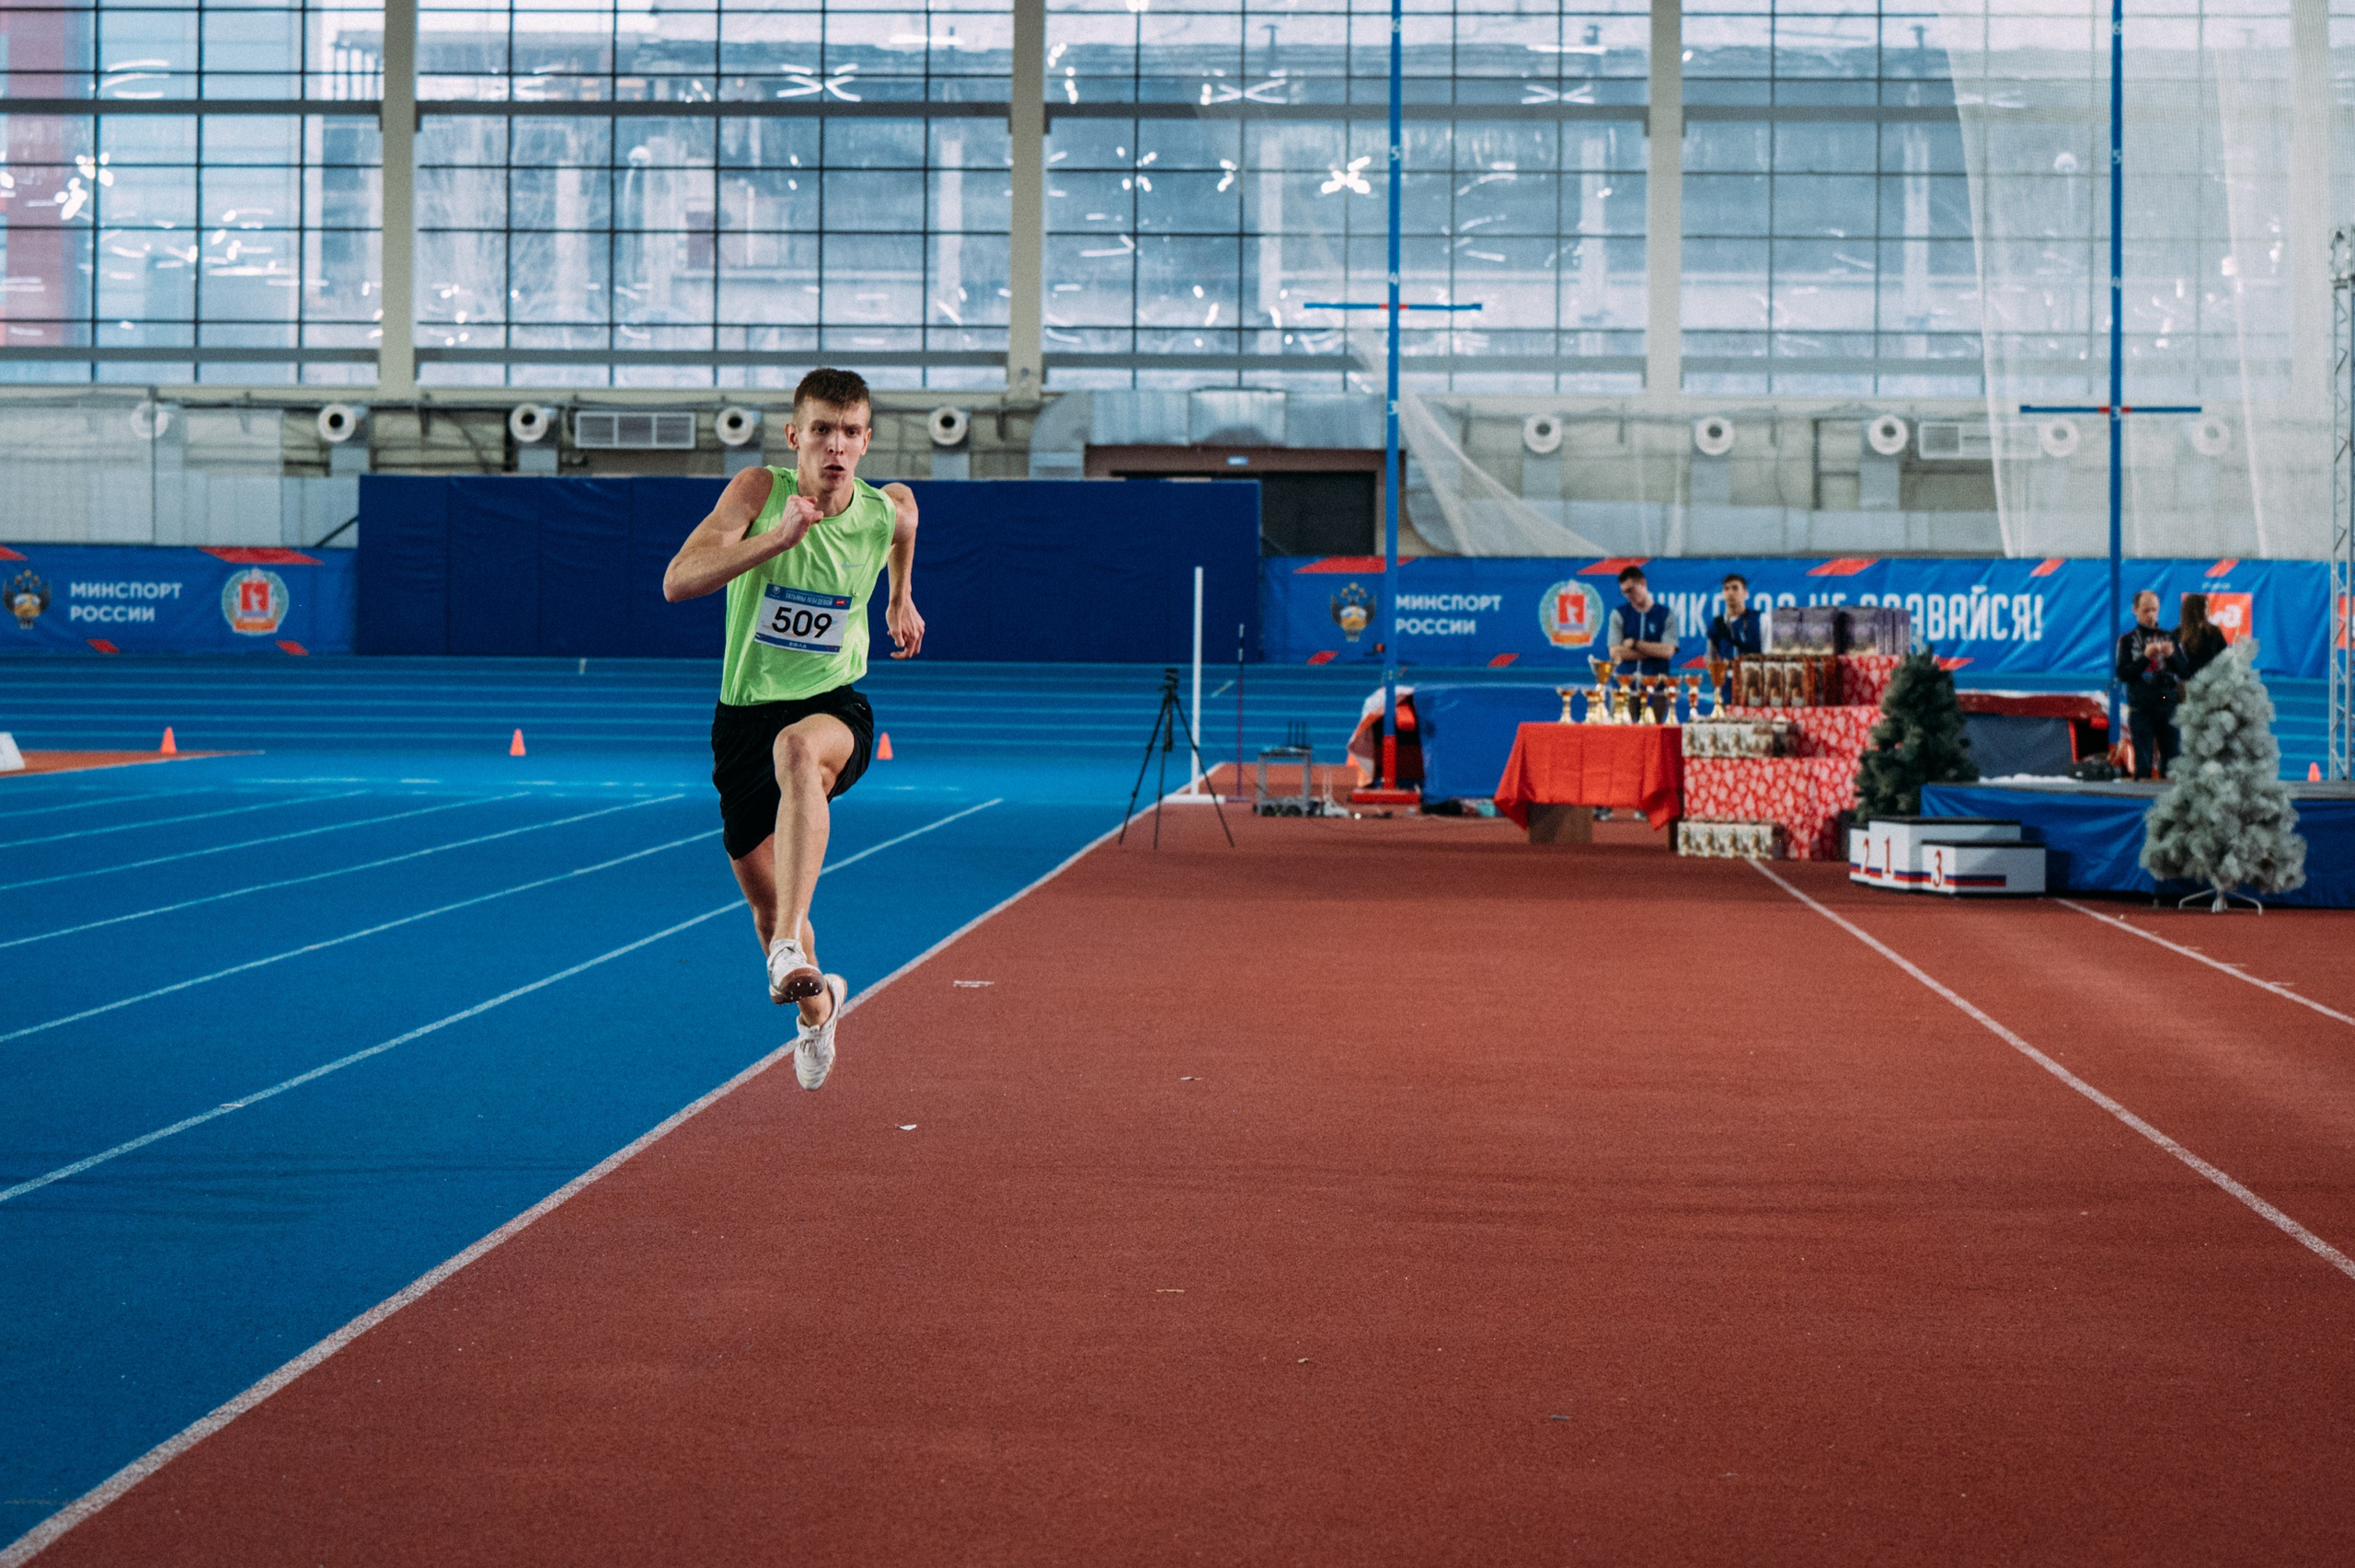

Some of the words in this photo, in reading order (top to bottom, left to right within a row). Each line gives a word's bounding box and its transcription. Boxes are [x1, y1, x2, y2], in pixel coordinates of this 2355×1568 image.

[70, 582, 182, 599] МИНСПОРТ
[1396, 594, 1502, 612] МИНСПОРТ
[70, 606, 155, 623] РОССИИ
[772, 606, 832, 638] 509
[1396, 618, 1476, 635] РОССИИ
[1864, 838, 1869, 874] 2
[1884, 837, 1890, 873] 1
[1933, 850, 1942, 887] 3
